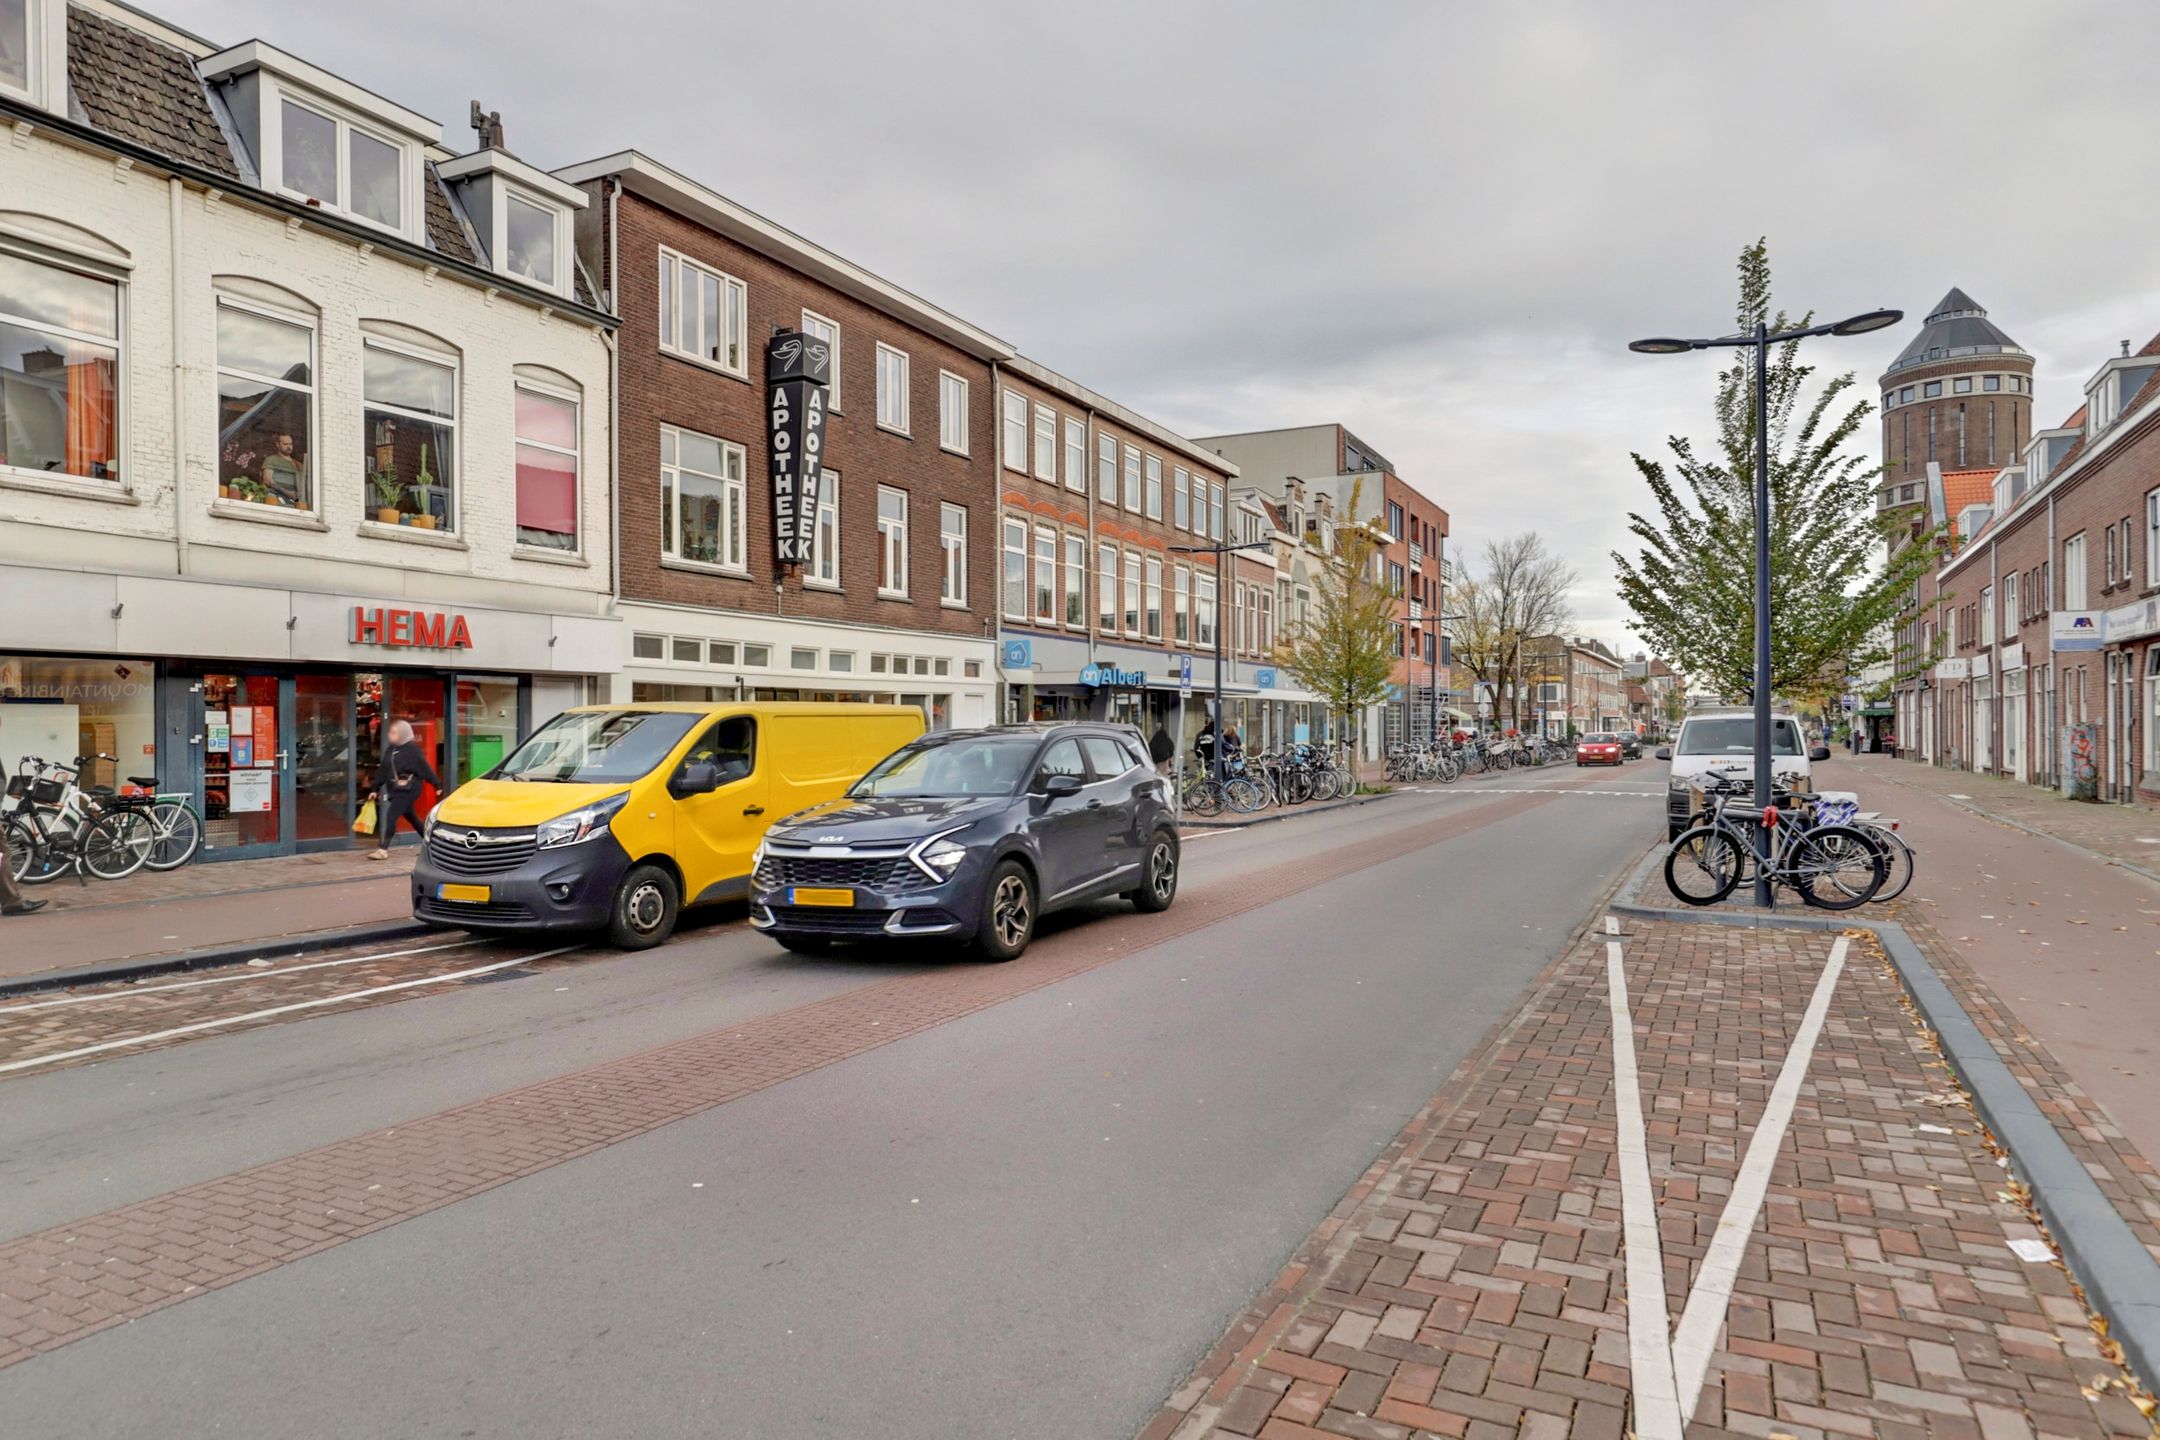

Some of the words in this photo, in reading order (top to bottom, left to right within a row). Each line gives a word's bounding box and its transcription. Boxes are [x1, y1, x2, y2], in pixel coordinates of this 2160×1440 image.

[772, 387, 795, 560] APOTHEEK
[797, 388, 822, 561] APOTHEEK
[350, 606, 473, 649] HEMA
[1101, 668, 1143, 686] Albert
